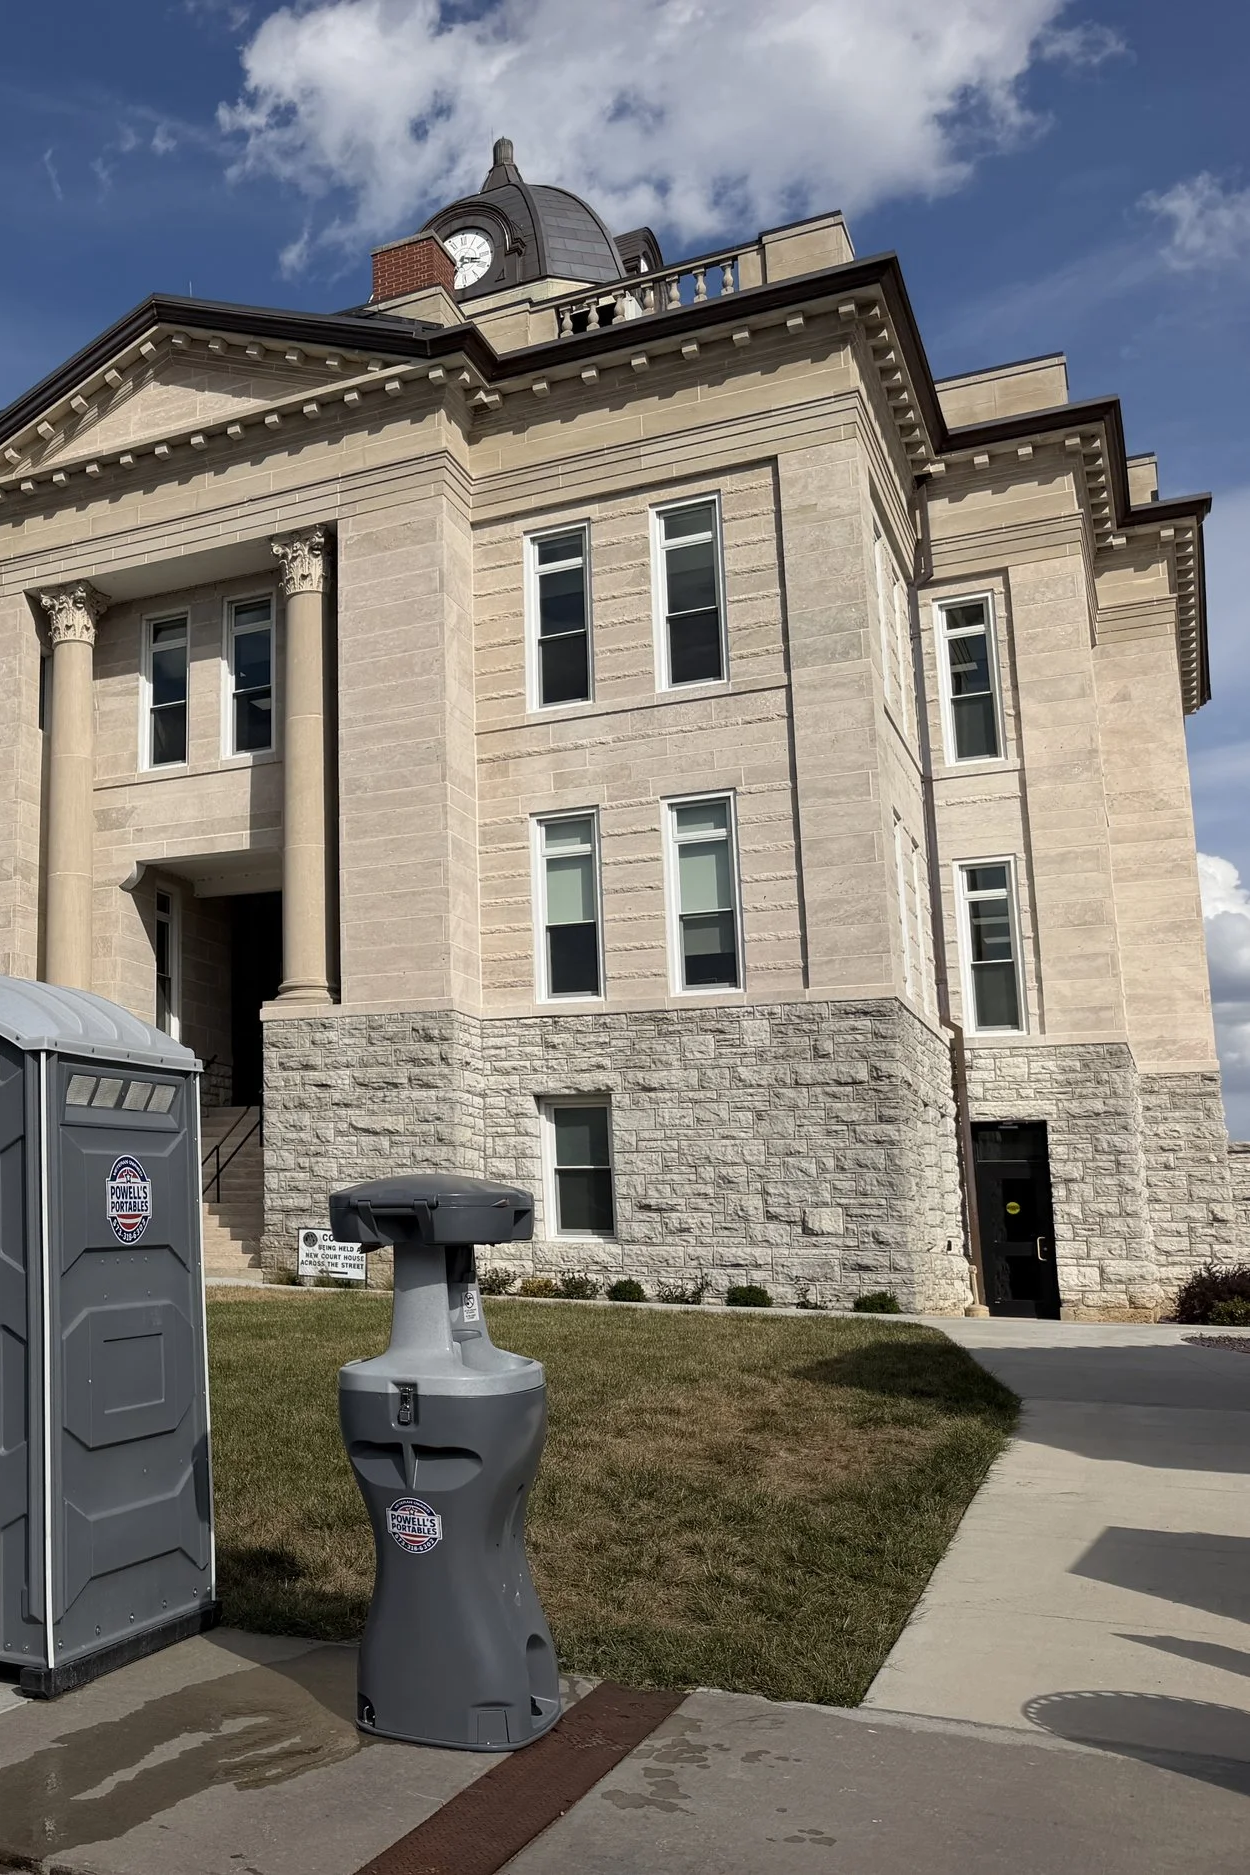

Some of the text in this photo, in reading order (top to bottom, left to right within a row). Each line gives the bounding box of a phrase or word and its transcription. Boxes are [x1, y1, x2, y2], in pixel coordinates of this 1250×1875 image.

[110, 1185, 148, 1200] POWELL'S
[110, 1200, 149, 1213] PORTABLES
[318, 1244, 337, 1252] BEING
[300, 1259, 325, 1267] ACROSS
[341, 1262, 365, 1270] STREET
[391, 1513, 436, 1528] POWELL'S
[391, 1522, 437, 1536] PORTABLES
